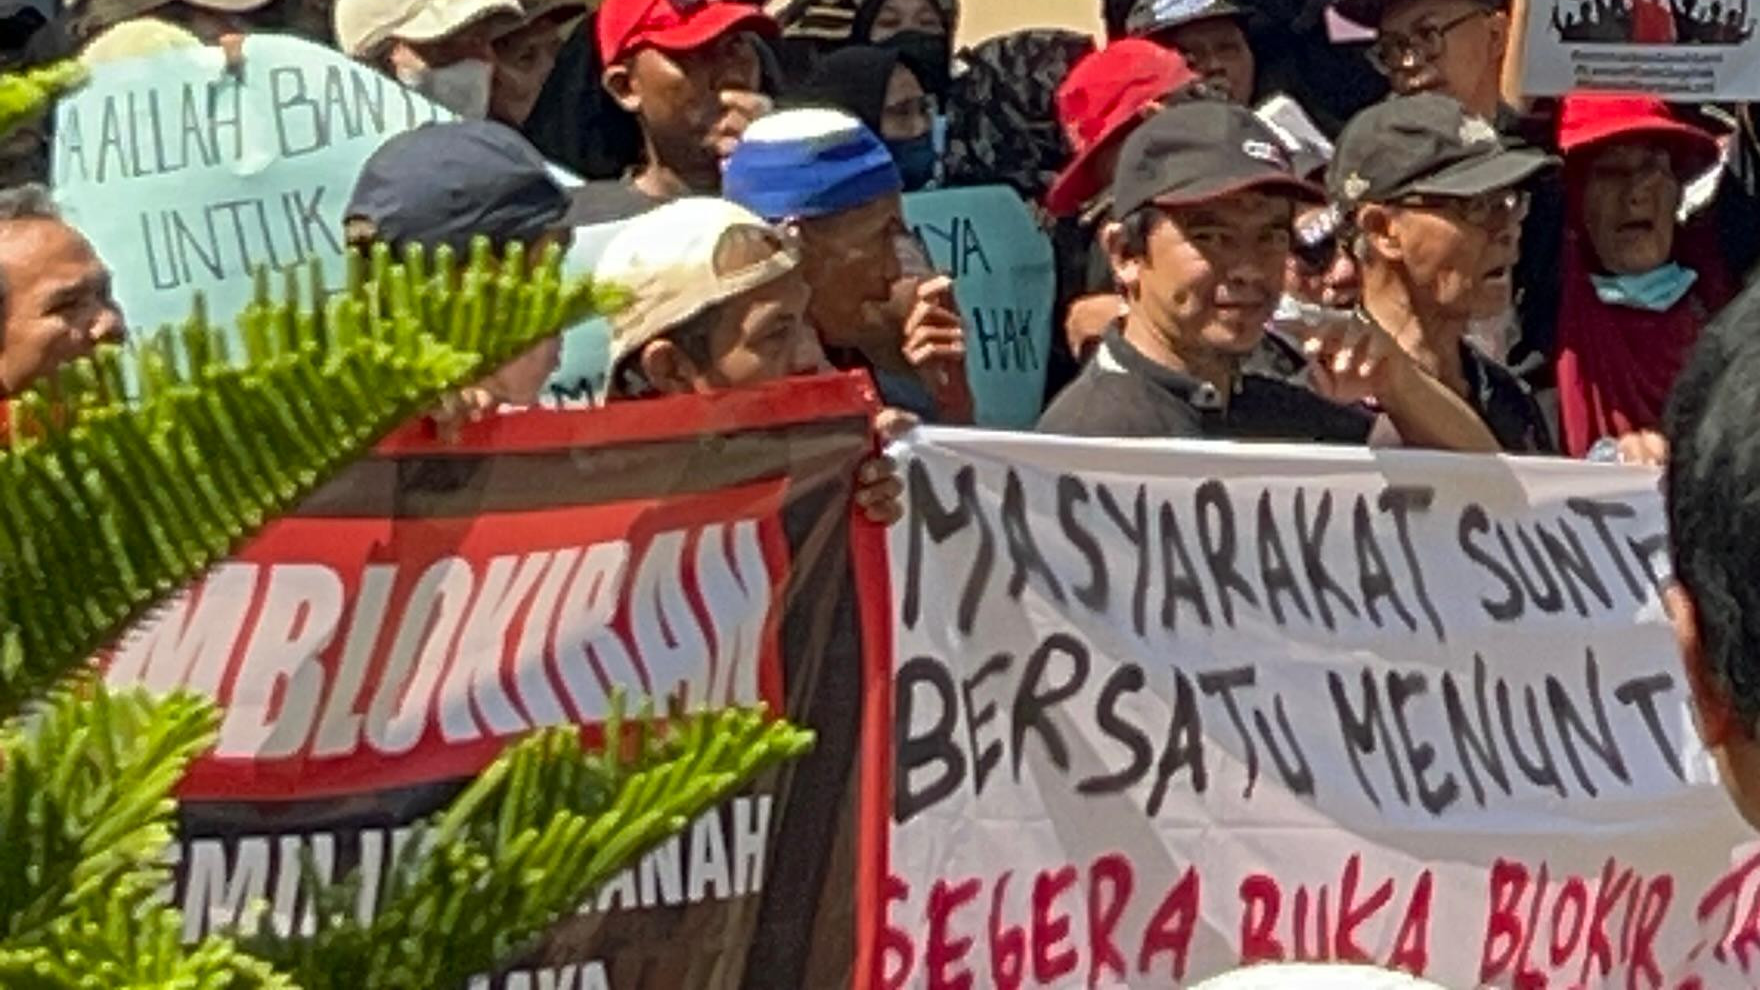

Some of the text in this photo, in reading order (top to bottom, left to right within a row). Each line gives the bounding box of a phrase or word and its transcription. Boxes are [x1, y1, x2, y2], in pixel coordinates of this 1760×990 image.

[96, 73, 243, 184] ALLAH
[270, 64, 443, 160] BAN
[141, 185, 344, 292] UNTUK
[972, 306, 1039, 373] HAK
[902, 457, 1447, 644] MASYARAKAT
[893, 631, 1688, 822] BERSATU MENUNT
[1480, 856, 1674, 990] BLOKIR
